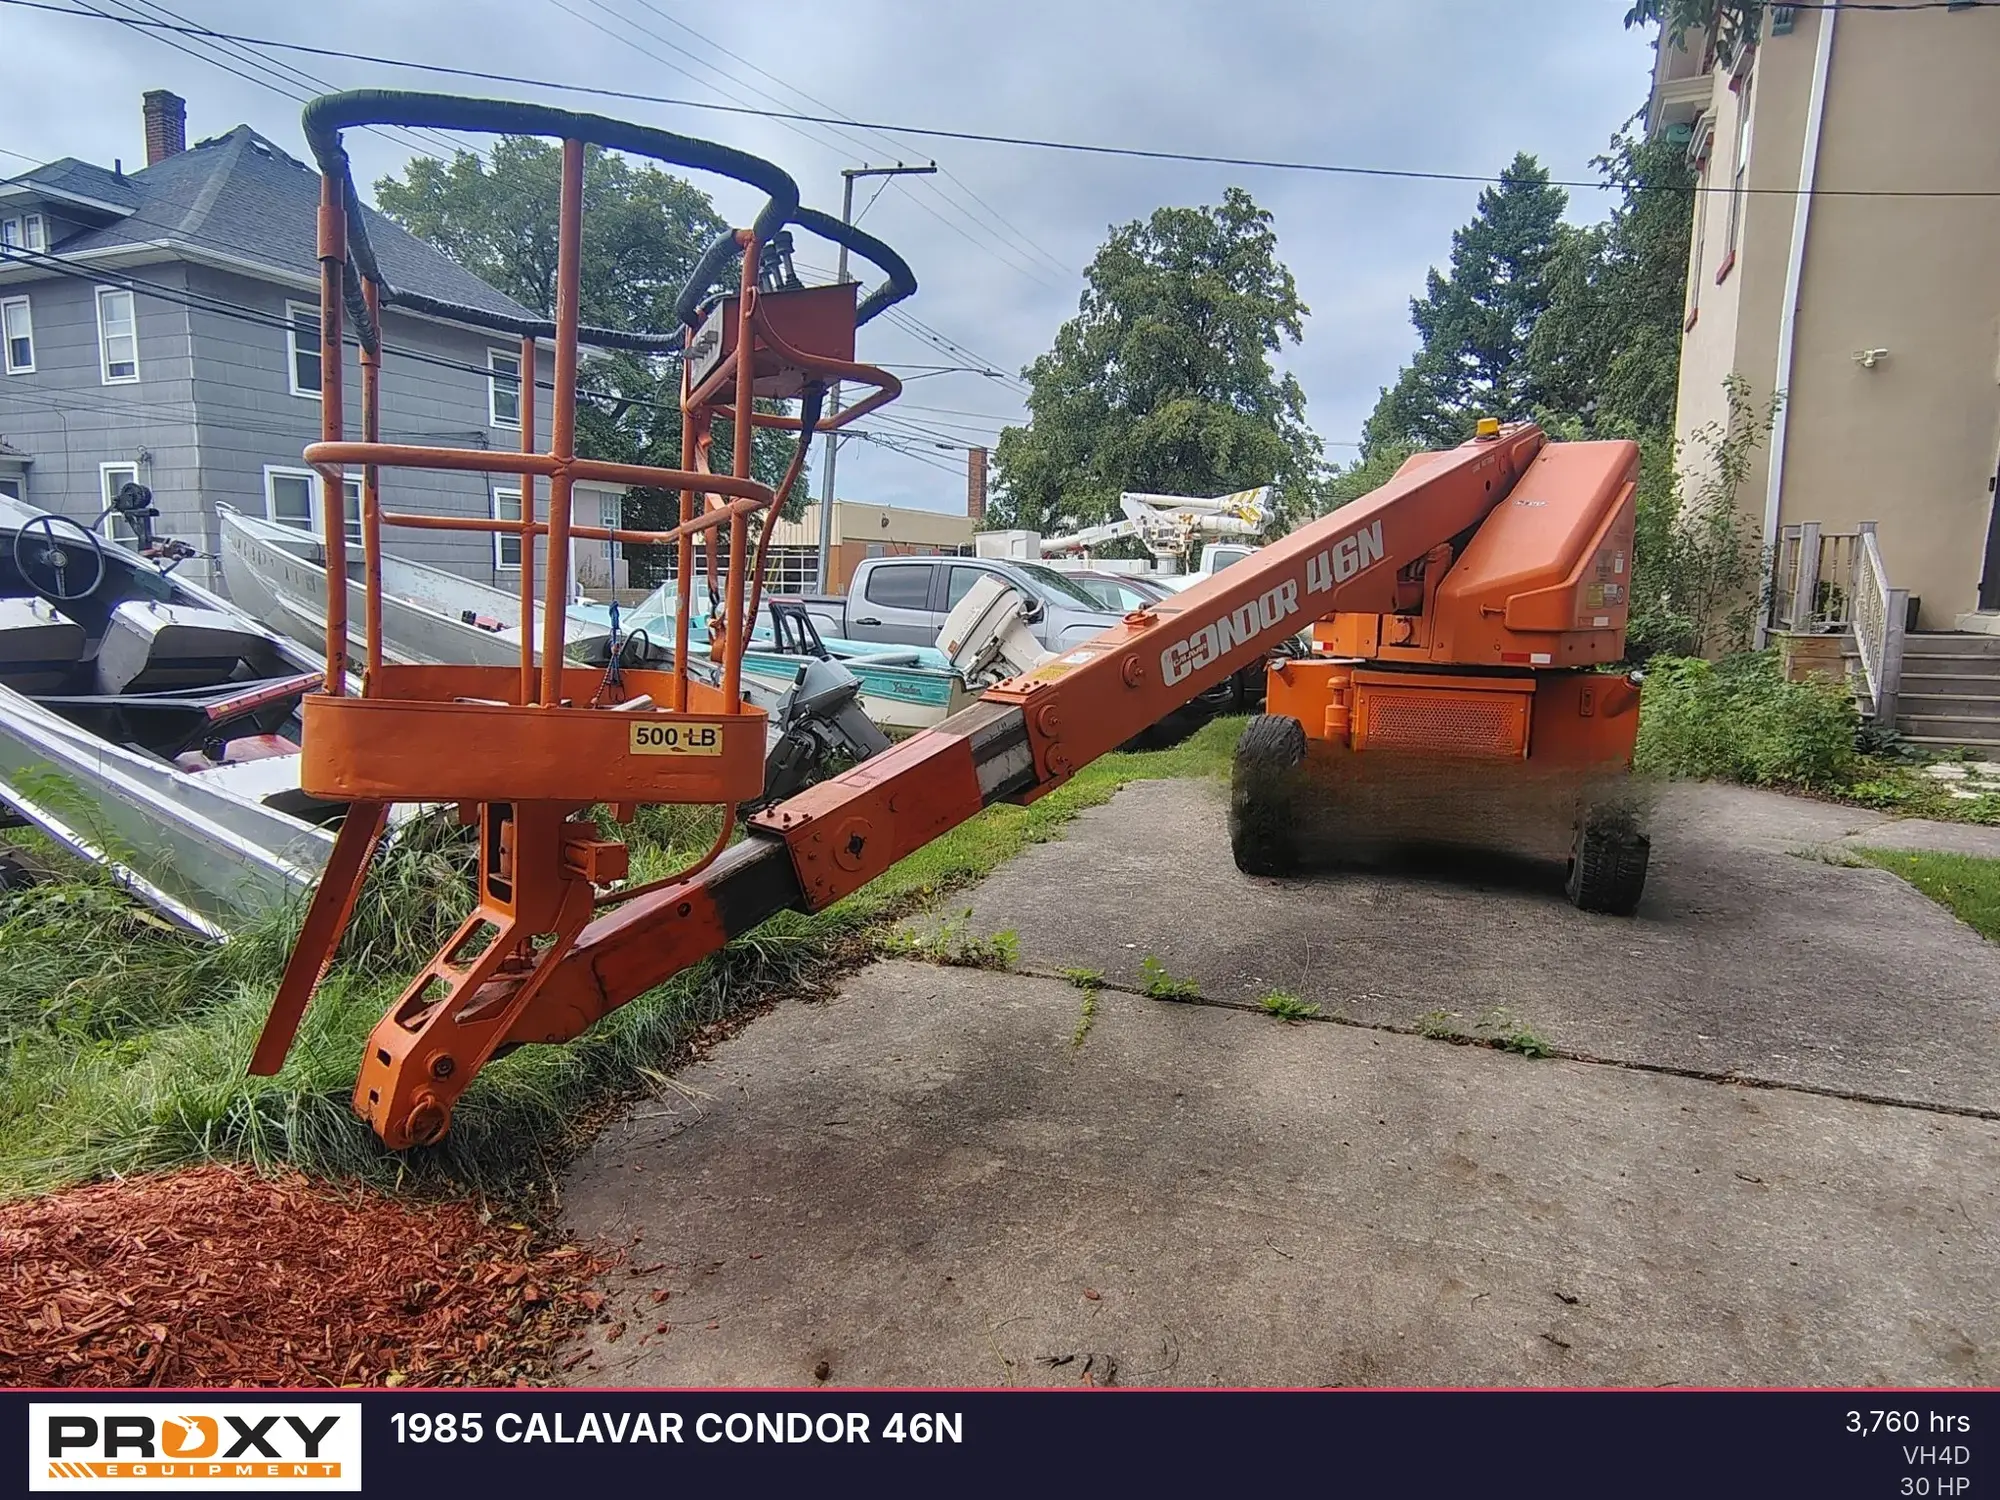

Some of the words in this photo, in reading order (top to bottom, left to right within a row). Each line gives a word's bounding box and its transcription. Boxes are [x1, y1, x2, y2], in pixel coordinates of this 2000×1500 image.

[1160, 578, 1300, 687] CONDOR
[1306, 519, 1384, 595] 46N
[636, 727, 678, 746] 500
[688, 728, 716, 747] LB
